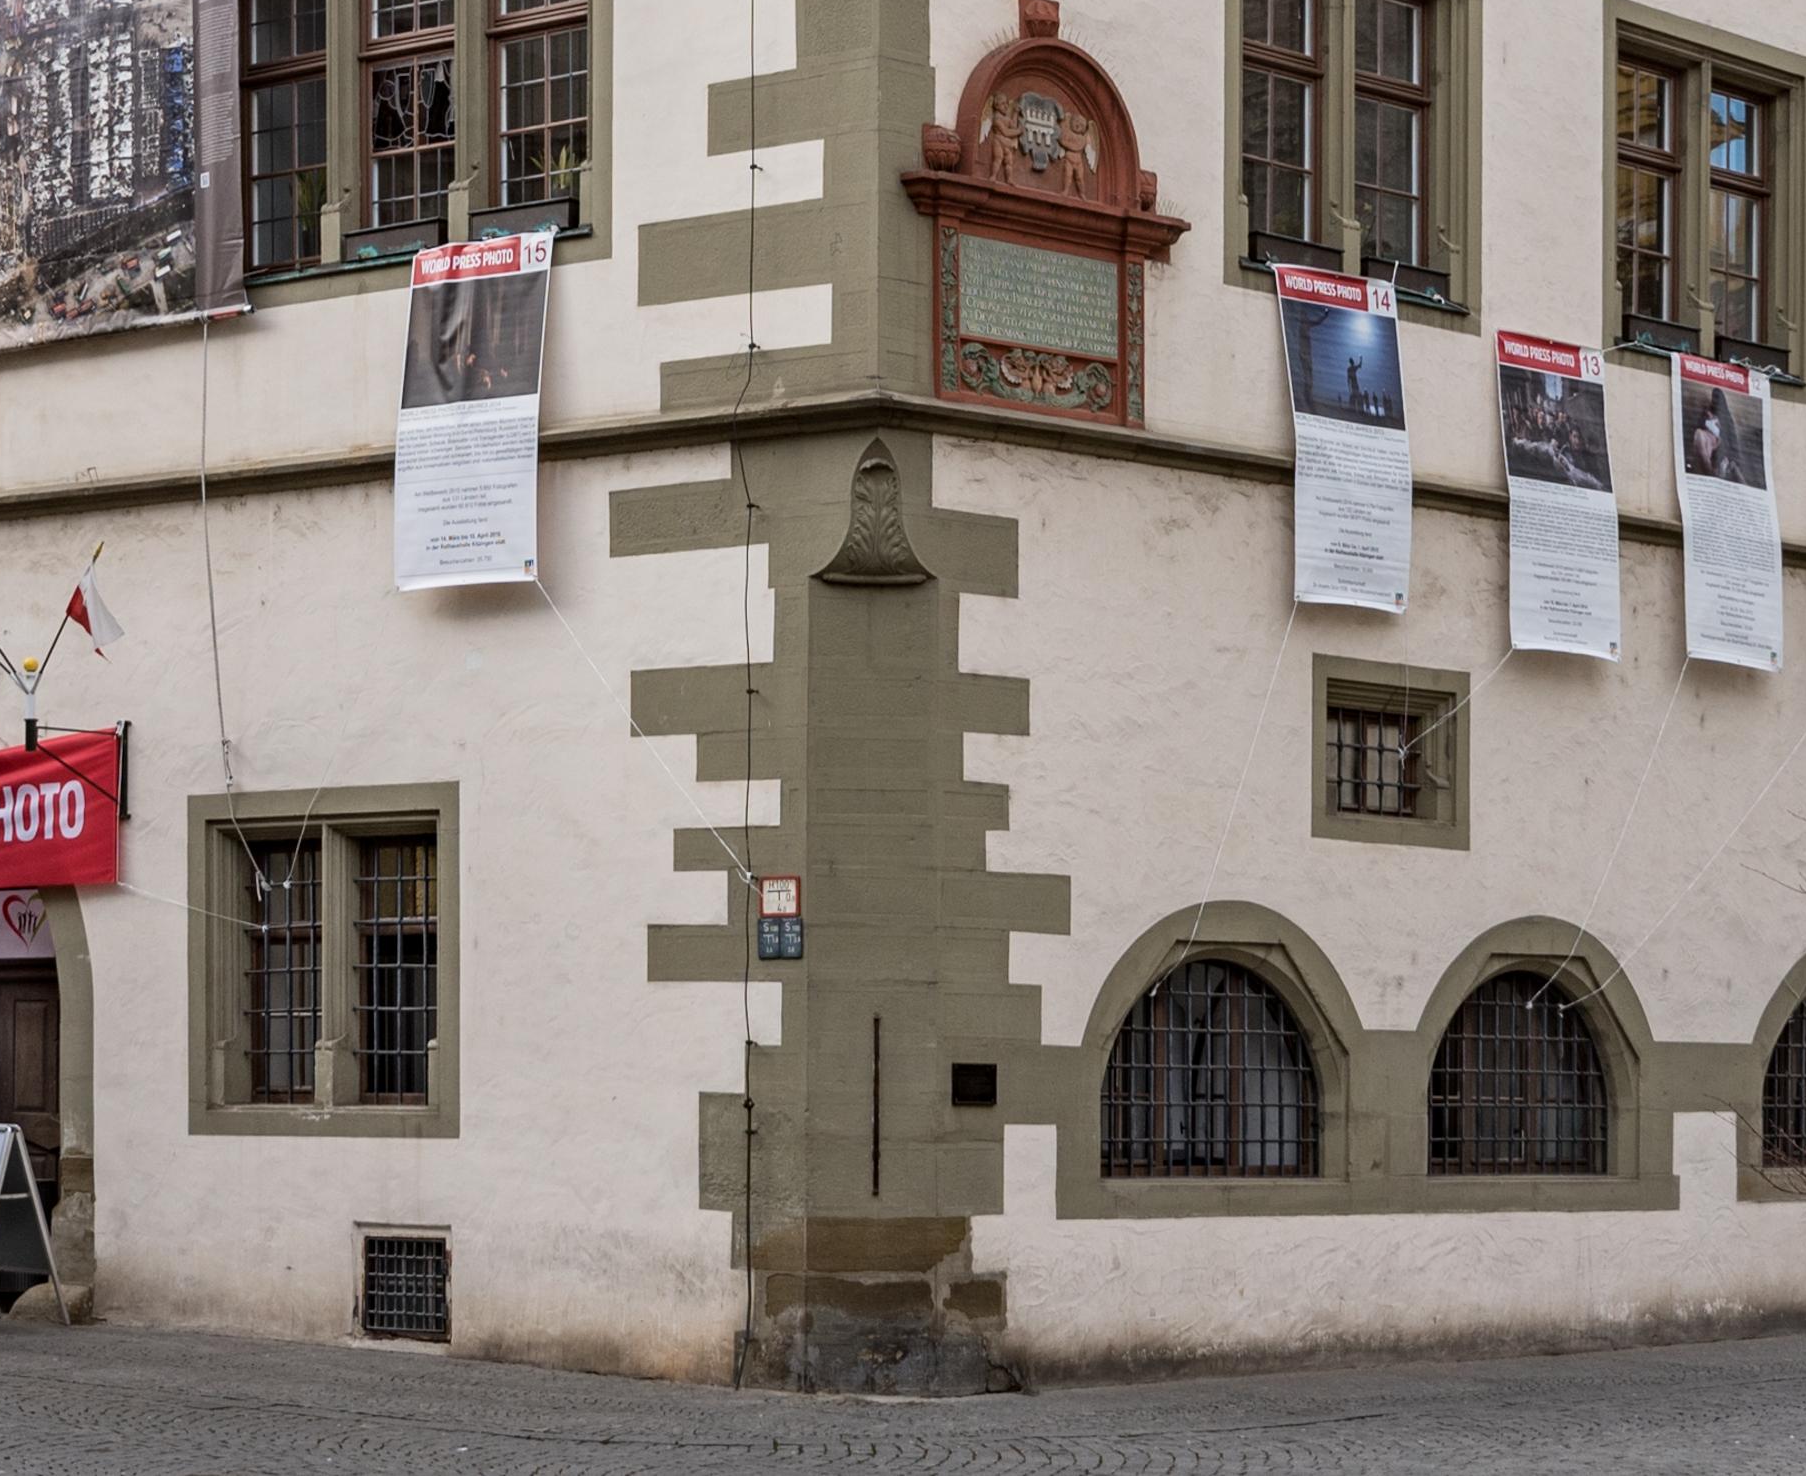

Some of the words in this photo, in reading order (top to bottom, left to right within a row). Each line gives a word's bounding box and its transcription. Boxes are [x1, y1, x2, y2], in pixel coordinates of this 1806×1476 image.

[422, 257, 450, 274] WORLD
[452, 252, 481, 270] PRESS
[483, 248, 513, 266] PHOTO
[524, 240, 547, 264] 15
[1284, 274, 1313, 292] WORLD
[1313, 280, 1336, 297] PRESS
[1337, 284, 1361, 302] PHOTO
[1372, 288, 1391, 311] 14
[1504, 340, 1529, 358] WORLD
[1529, 346, 1551, 363] PRESS
[1552, 350, 1575, 368] PHOTO
[1583, 354, 1601, 376] 13
[1684, 359, 1706, 375] WORLD
[1706, 364, 1725, 380] PRESS
[1725, 369, 1745, 385] PHOTO
